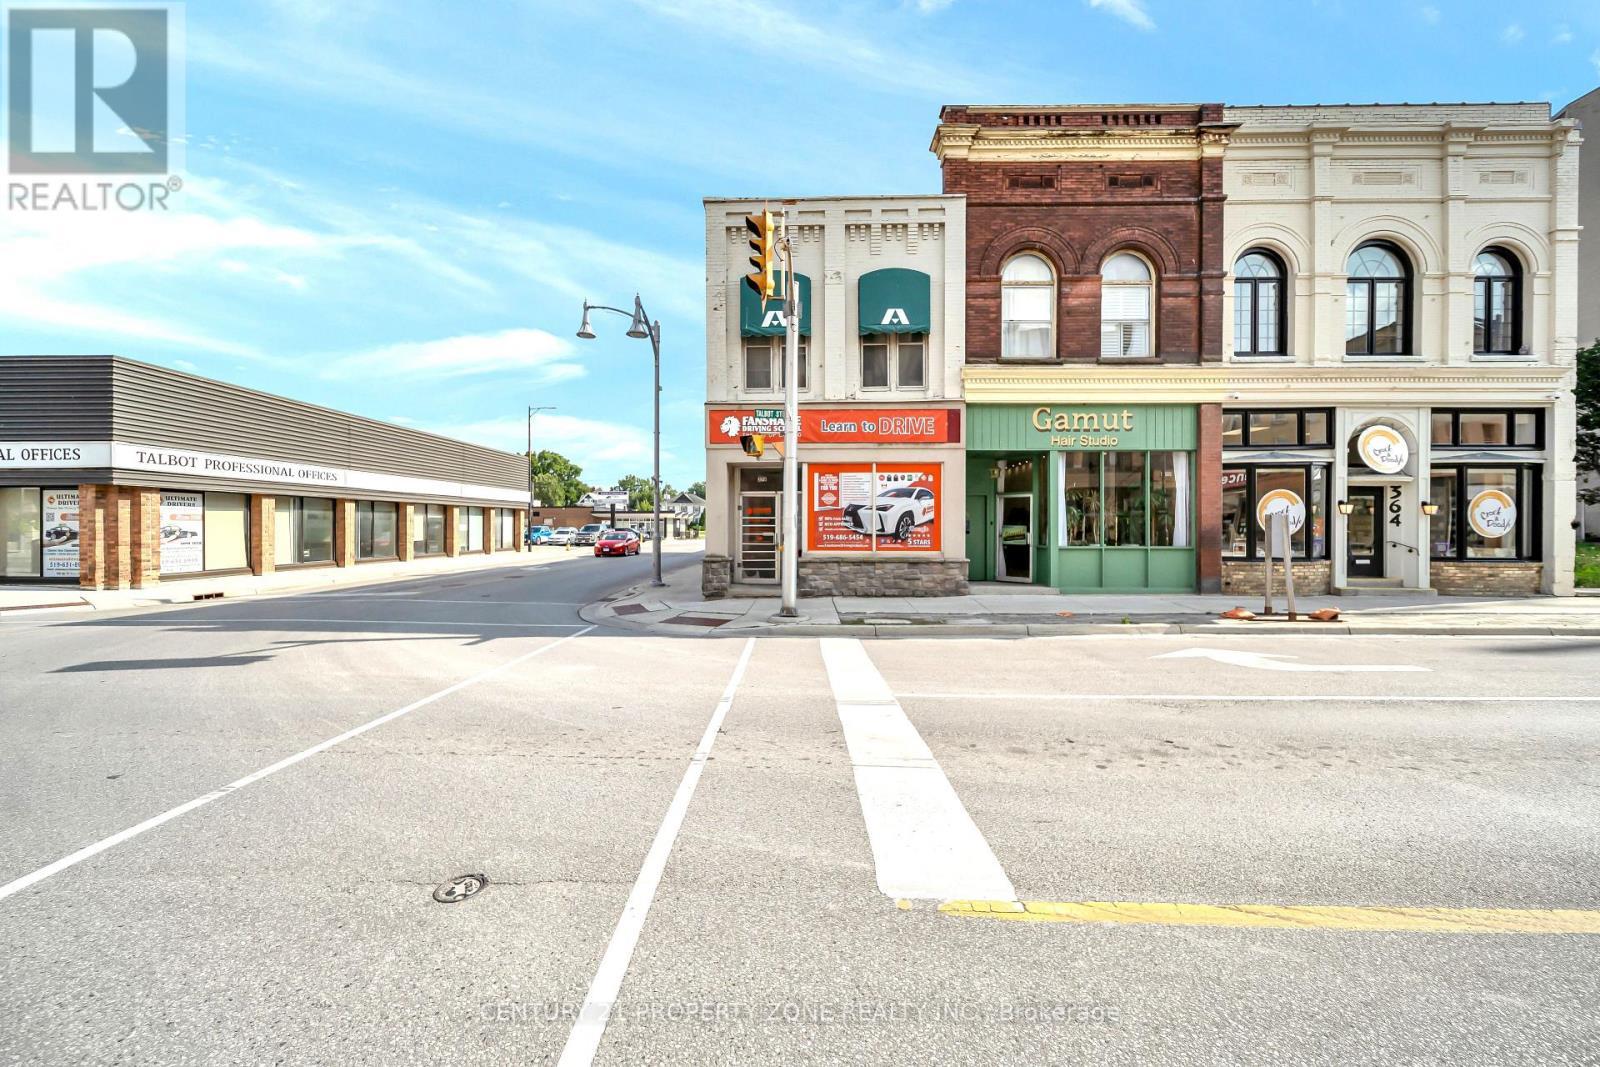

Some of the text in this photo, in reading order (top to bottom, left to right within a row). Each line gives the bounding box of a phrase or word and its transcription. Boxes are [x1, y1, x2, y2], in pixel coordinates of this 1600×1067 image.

[742, 416, 802, 426] FANSHAE
[756, 410, 774, 418] TALBOT
[1032, 407, 1133, 432] Gamut
[821, 416, 935, 435] Learn to DRIVE
[1051, 435, 1118, 447] Hair Studio
[21, 448, 81, 461] OFFICES
[136, 450, 338, 482] TALBOT PROFESSIONAL OFFICES
[1389, 485, 1402, 527] 364
